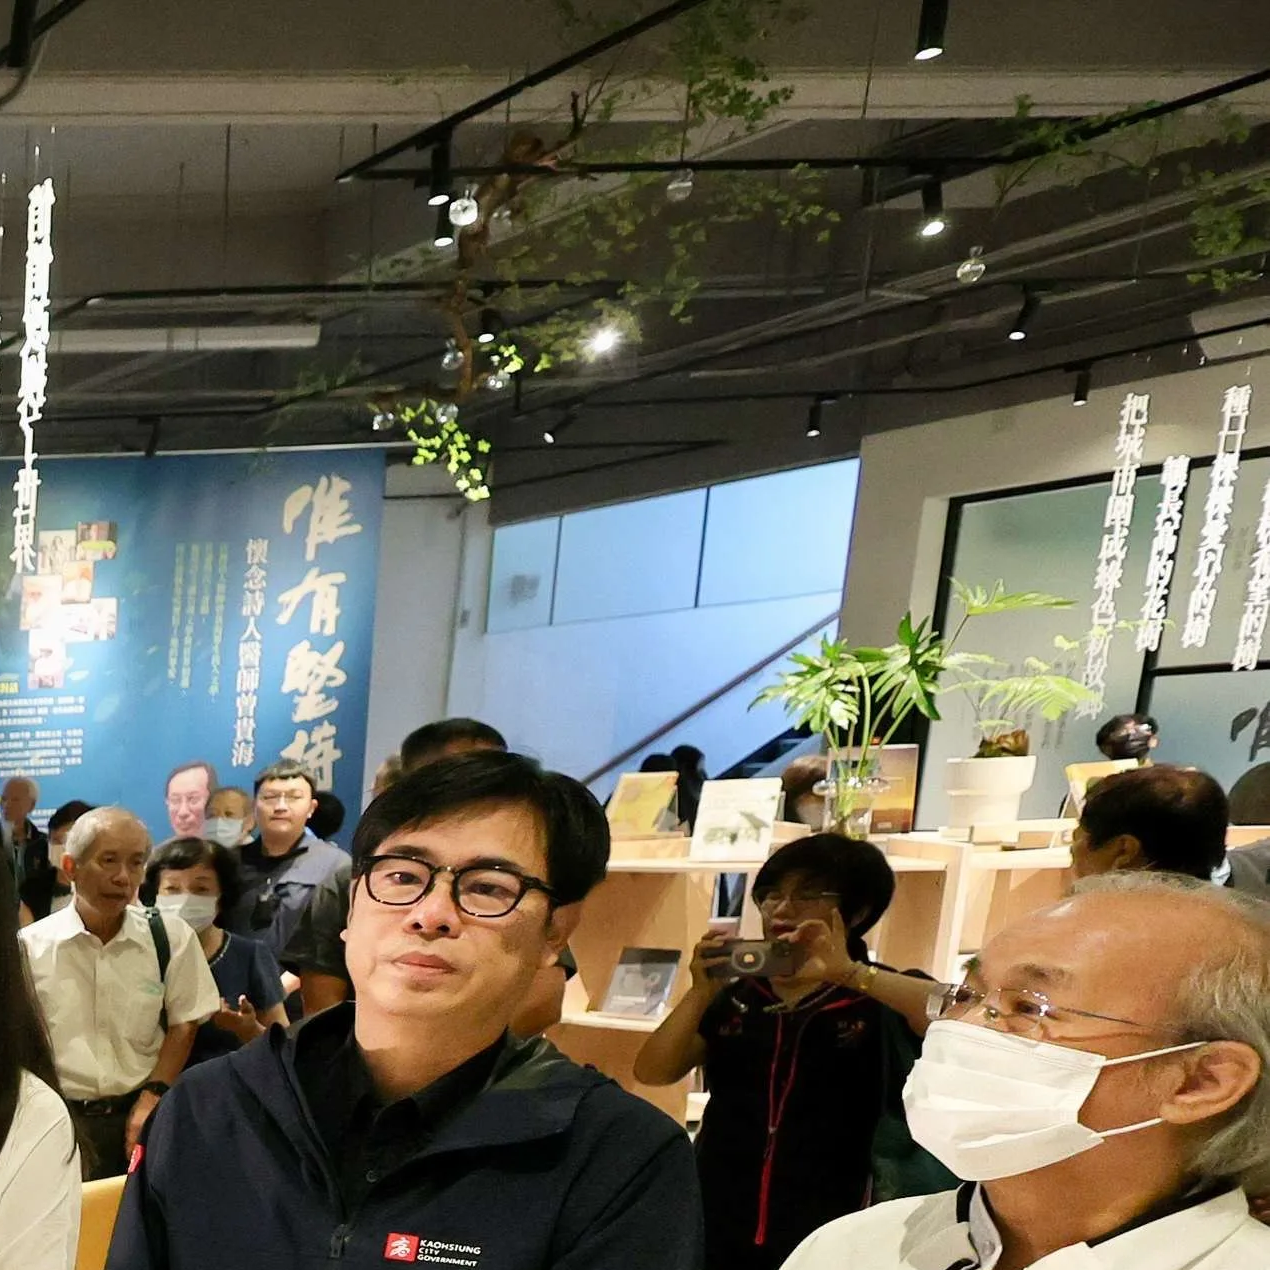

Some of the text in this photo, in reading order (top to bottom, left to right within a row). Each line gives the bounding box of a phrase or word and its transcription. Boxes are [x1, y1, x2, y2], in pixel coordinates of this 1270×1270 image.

[232, 537, 270, 768] 懷念詩人醫師曾貴海
[418, 1246, 440, 1257] CITY
[419, 1239, 481, 1255] KAOHSIUNG
[416, 1254, 478, 1268] GOVERNMENT
